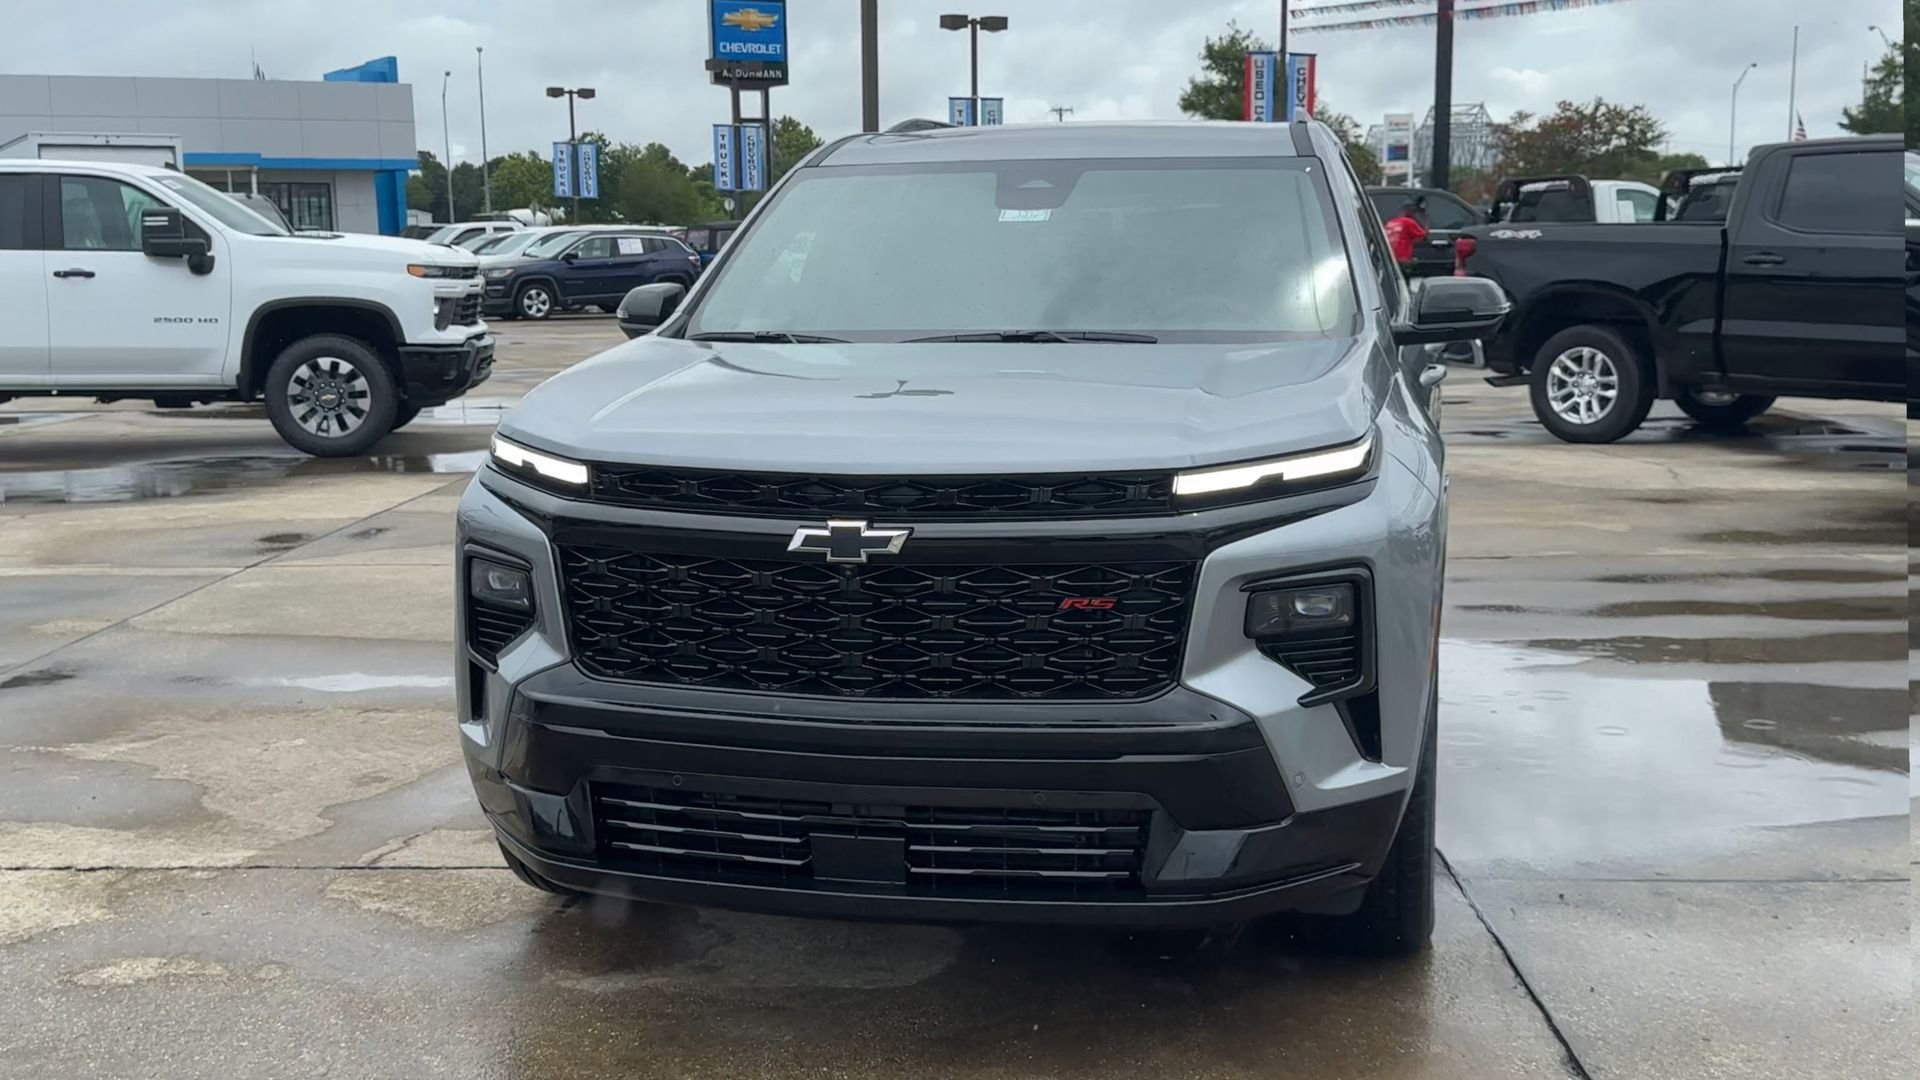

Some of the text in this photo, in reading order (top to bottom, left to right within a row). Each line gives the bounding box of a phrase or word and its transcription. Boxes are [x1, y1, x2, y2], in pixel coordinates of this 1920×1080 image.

[720, 41, 782, 54] CHEVROLET
[1254, 59, 1265, 100] USED
[559, 150, 567, 195] TRUCKS
[720, 134, 729, 187] TRUCKS
[747, 135, 757, 188] CHEVROLET
[1059, 597, 1116, 609] RS
